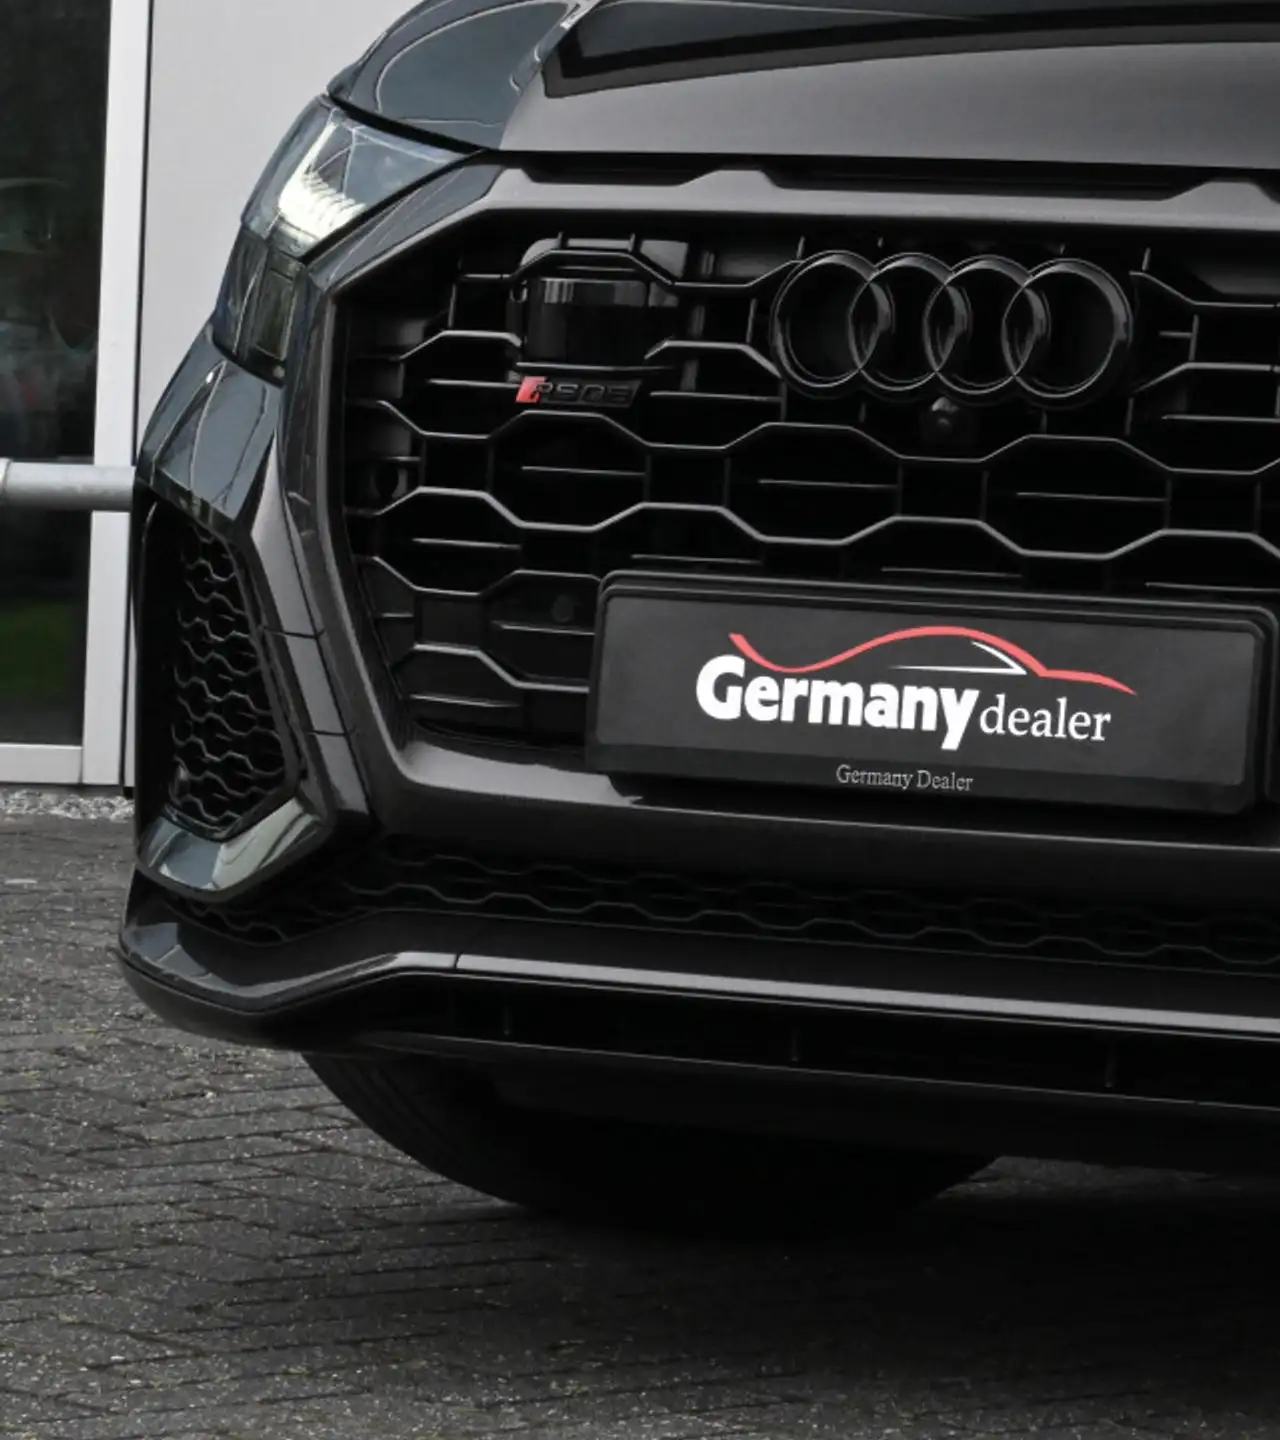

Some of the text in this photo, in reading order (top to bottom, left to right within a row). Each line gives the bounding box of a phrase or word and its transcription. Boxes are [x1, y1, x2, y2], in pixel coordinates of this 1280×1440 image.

[696, 654, 1112, 750] Germany dealer
[836, 763, 974, 791] Germany Dealer
